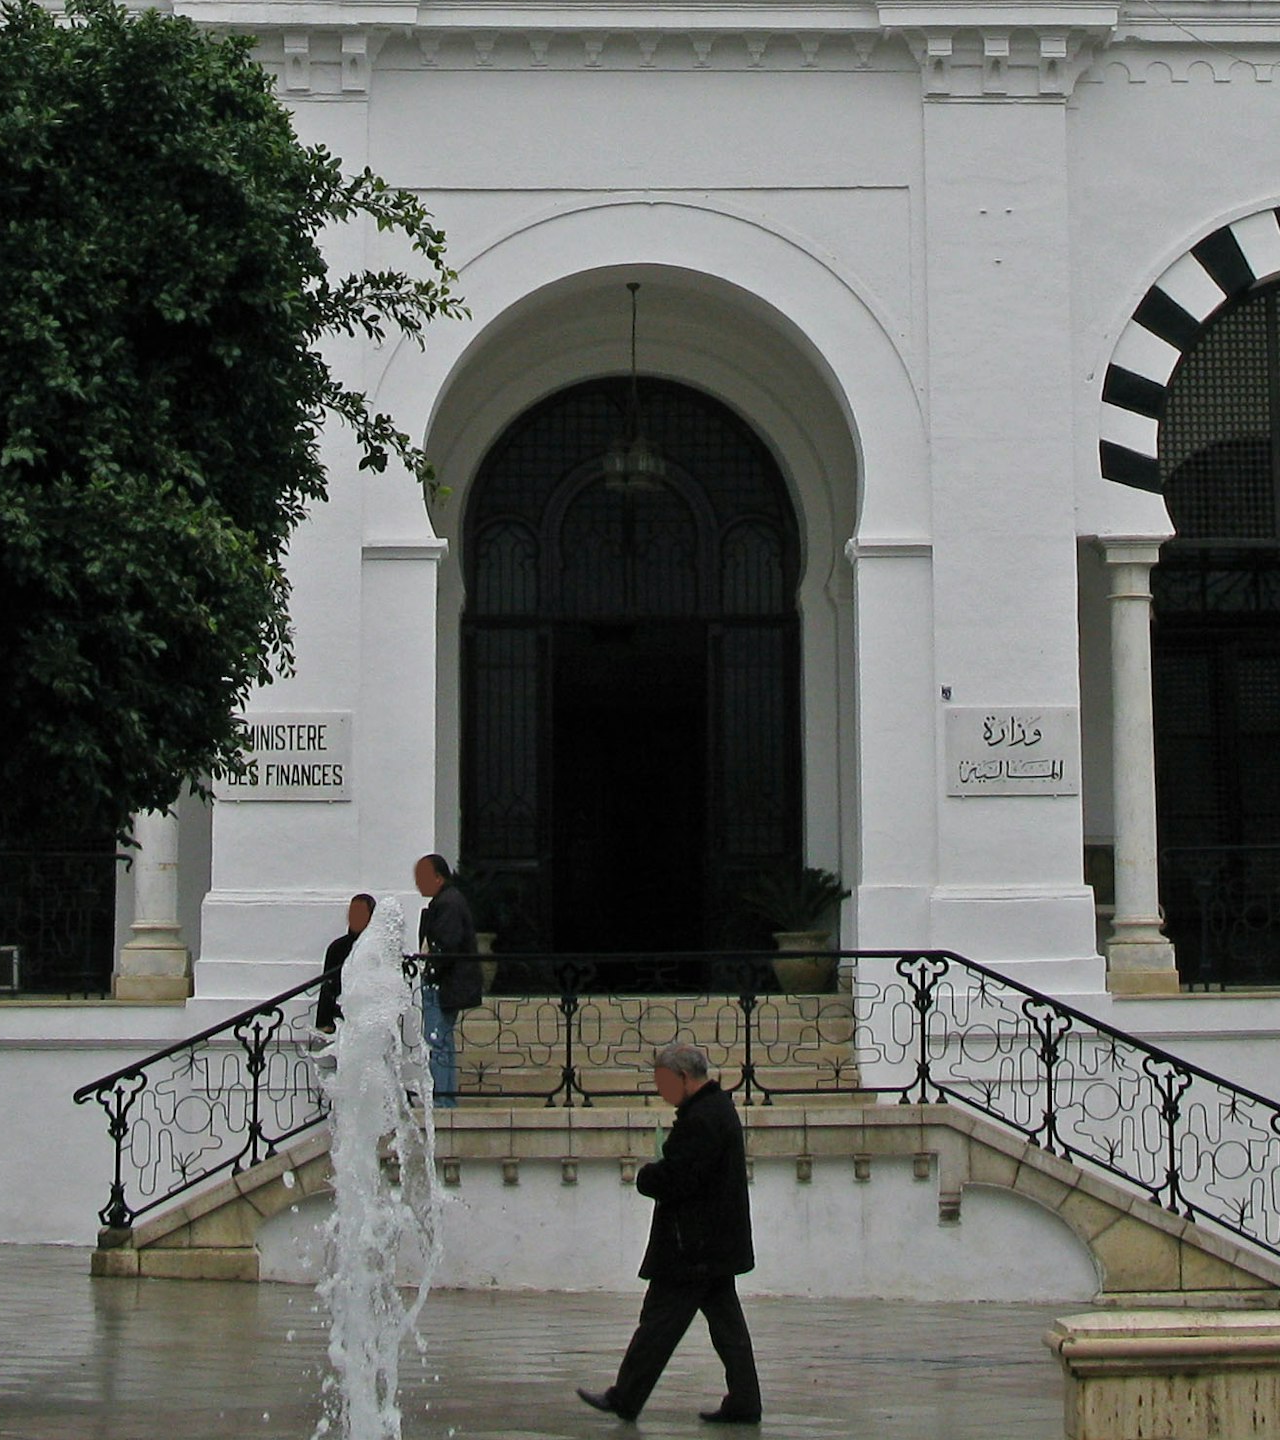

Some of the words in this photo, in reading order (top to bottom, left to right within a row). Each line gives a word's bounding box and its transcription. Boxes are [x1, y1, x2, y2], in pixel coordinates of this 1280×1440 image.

[242, 724, 327, 751] MINISTERE
[983, 716, 1042, 747] وزارة
[265, 764, 343, 786] FINANCES
[959, 760, 1063, 783] المالية
